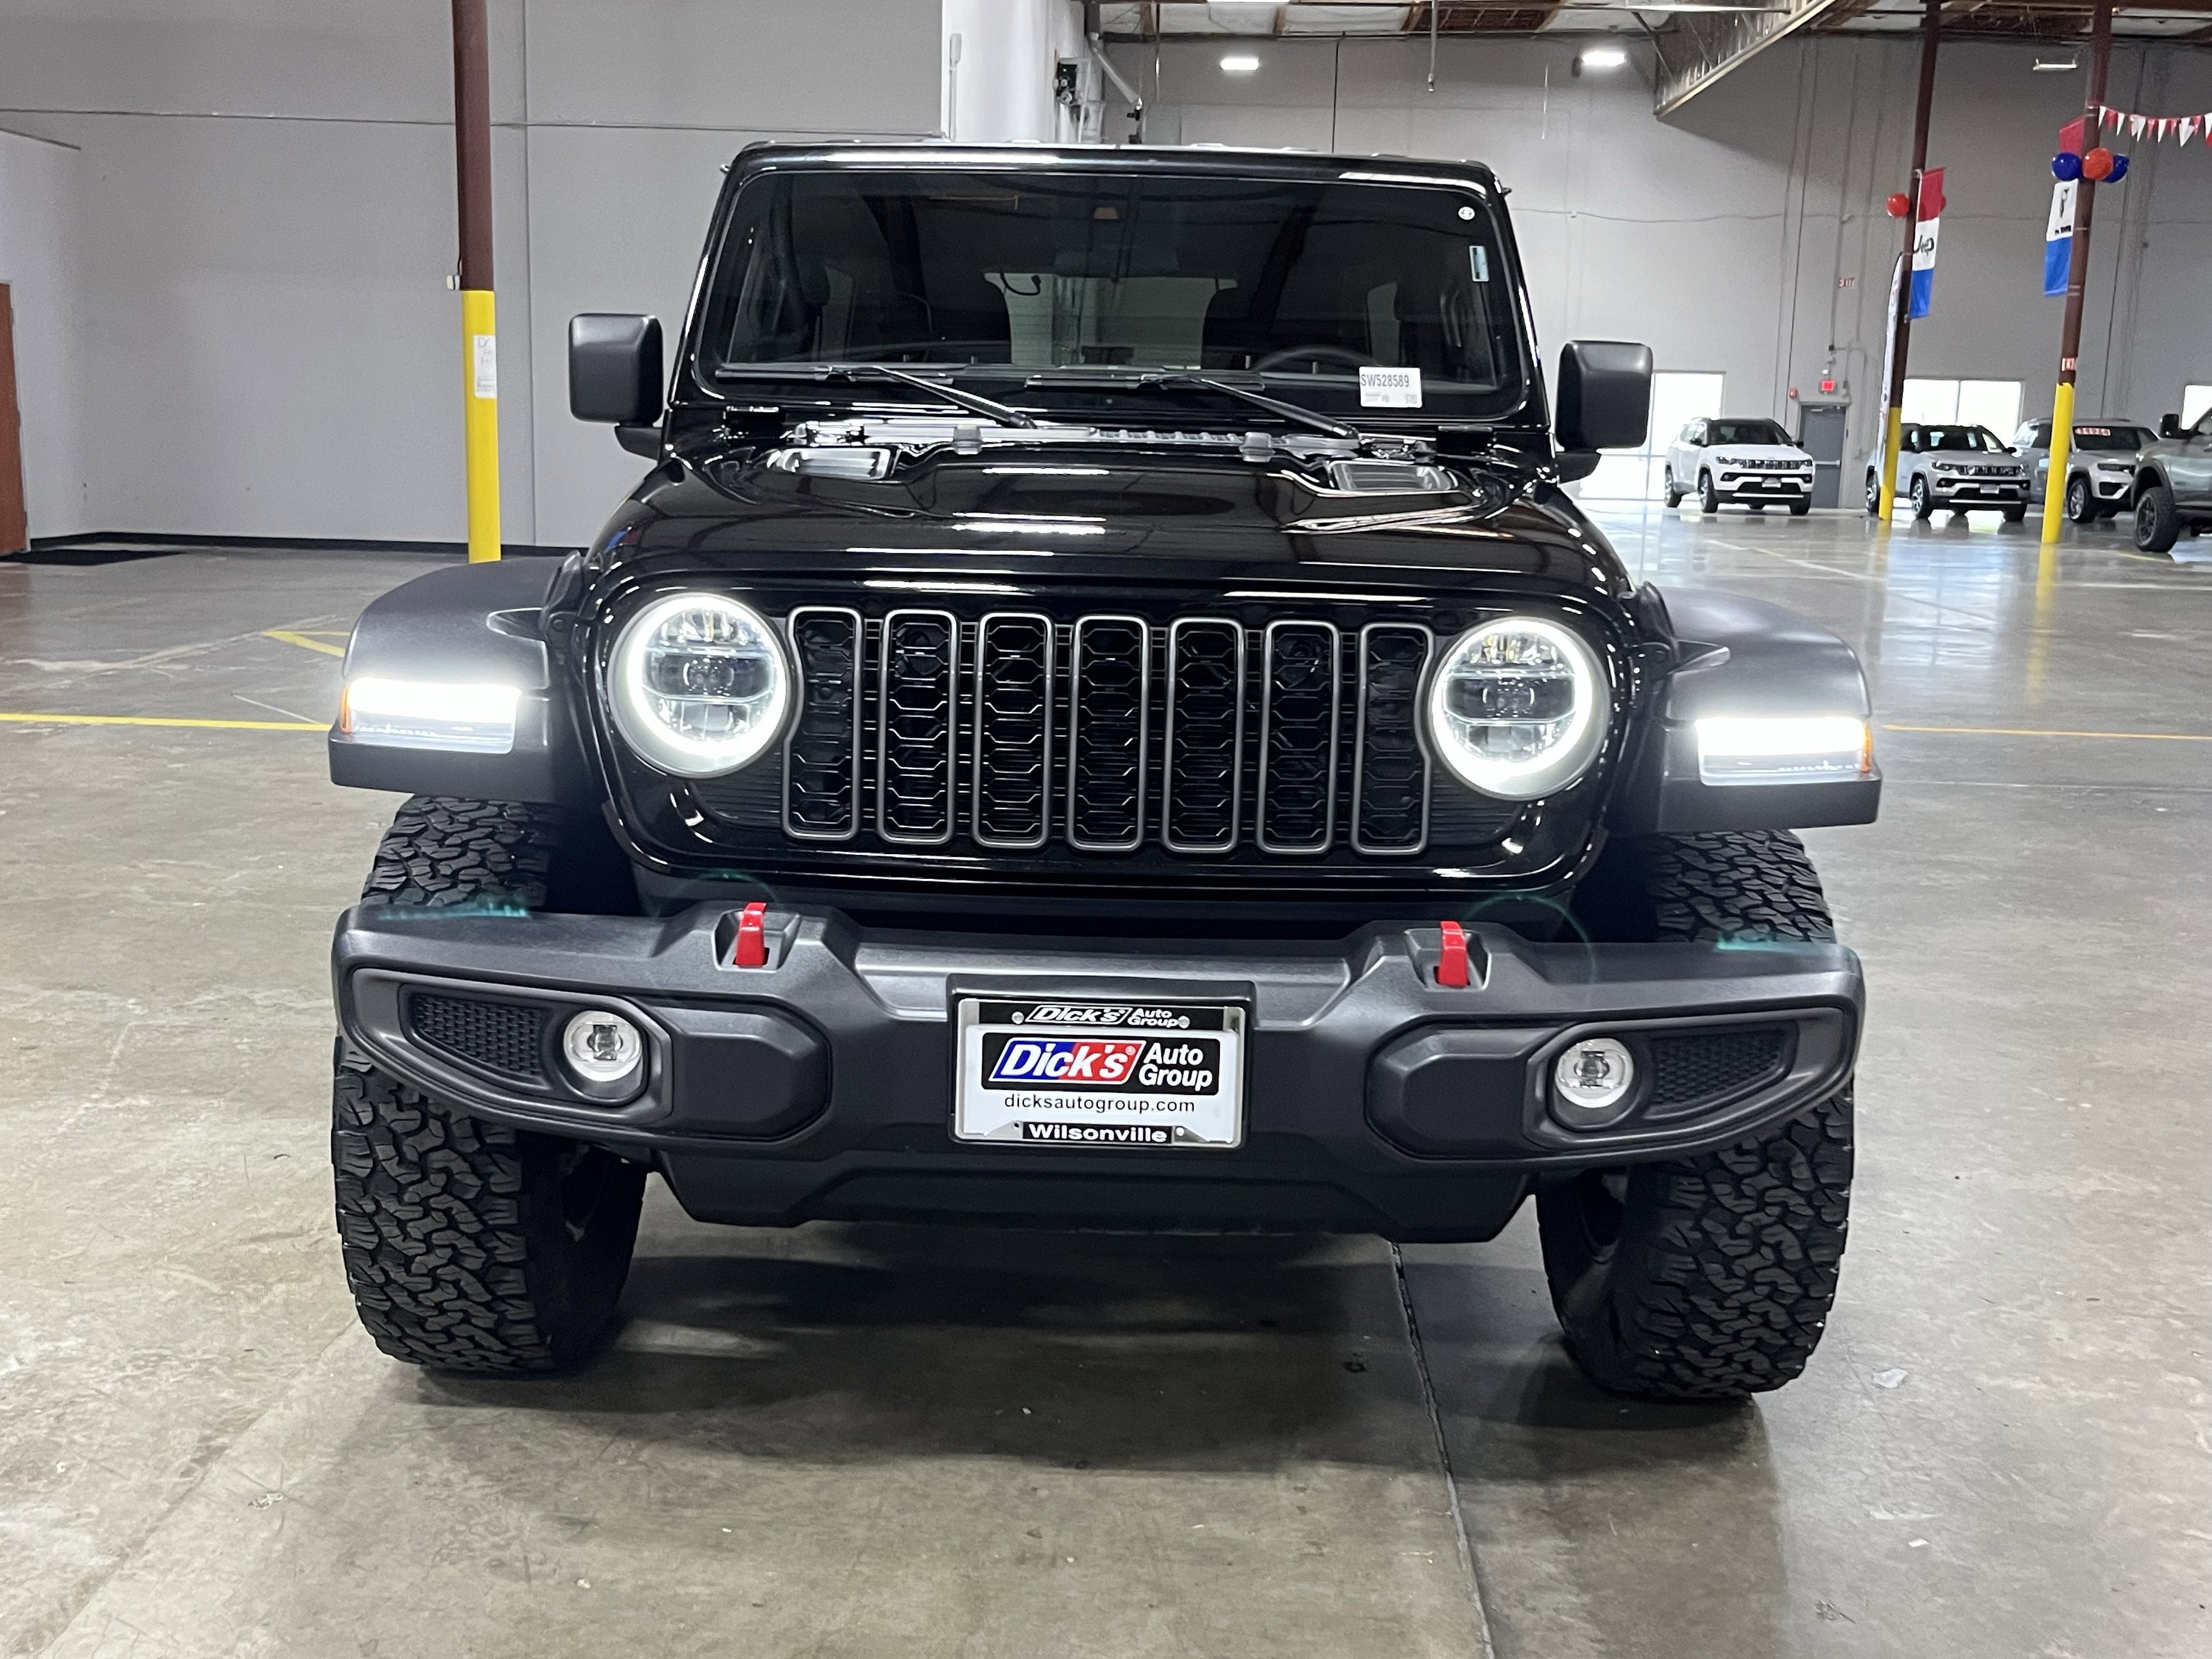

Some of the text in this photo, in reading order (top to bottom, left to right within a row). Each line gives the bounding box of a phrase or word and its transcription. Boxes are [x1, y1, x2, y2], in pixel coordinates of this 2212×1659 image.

[1361, 374, 1409, 387] SW528589
[1034, 1007, 1123, 1022] Dick's
[1127, 1016, 1179, 1028] Group
[1132, 1008, 1172, 1018] Auto
[1000, 1043, 1129, 1079] Dick's
[1144, 1042, 1204, 1066] Auto
[1138, 1064, 1213, 1091] Group
[1005, 1094, 1195, 1114] dicksautogroup.com
[1029, 1124, 1167, 1143] Wilsonville
